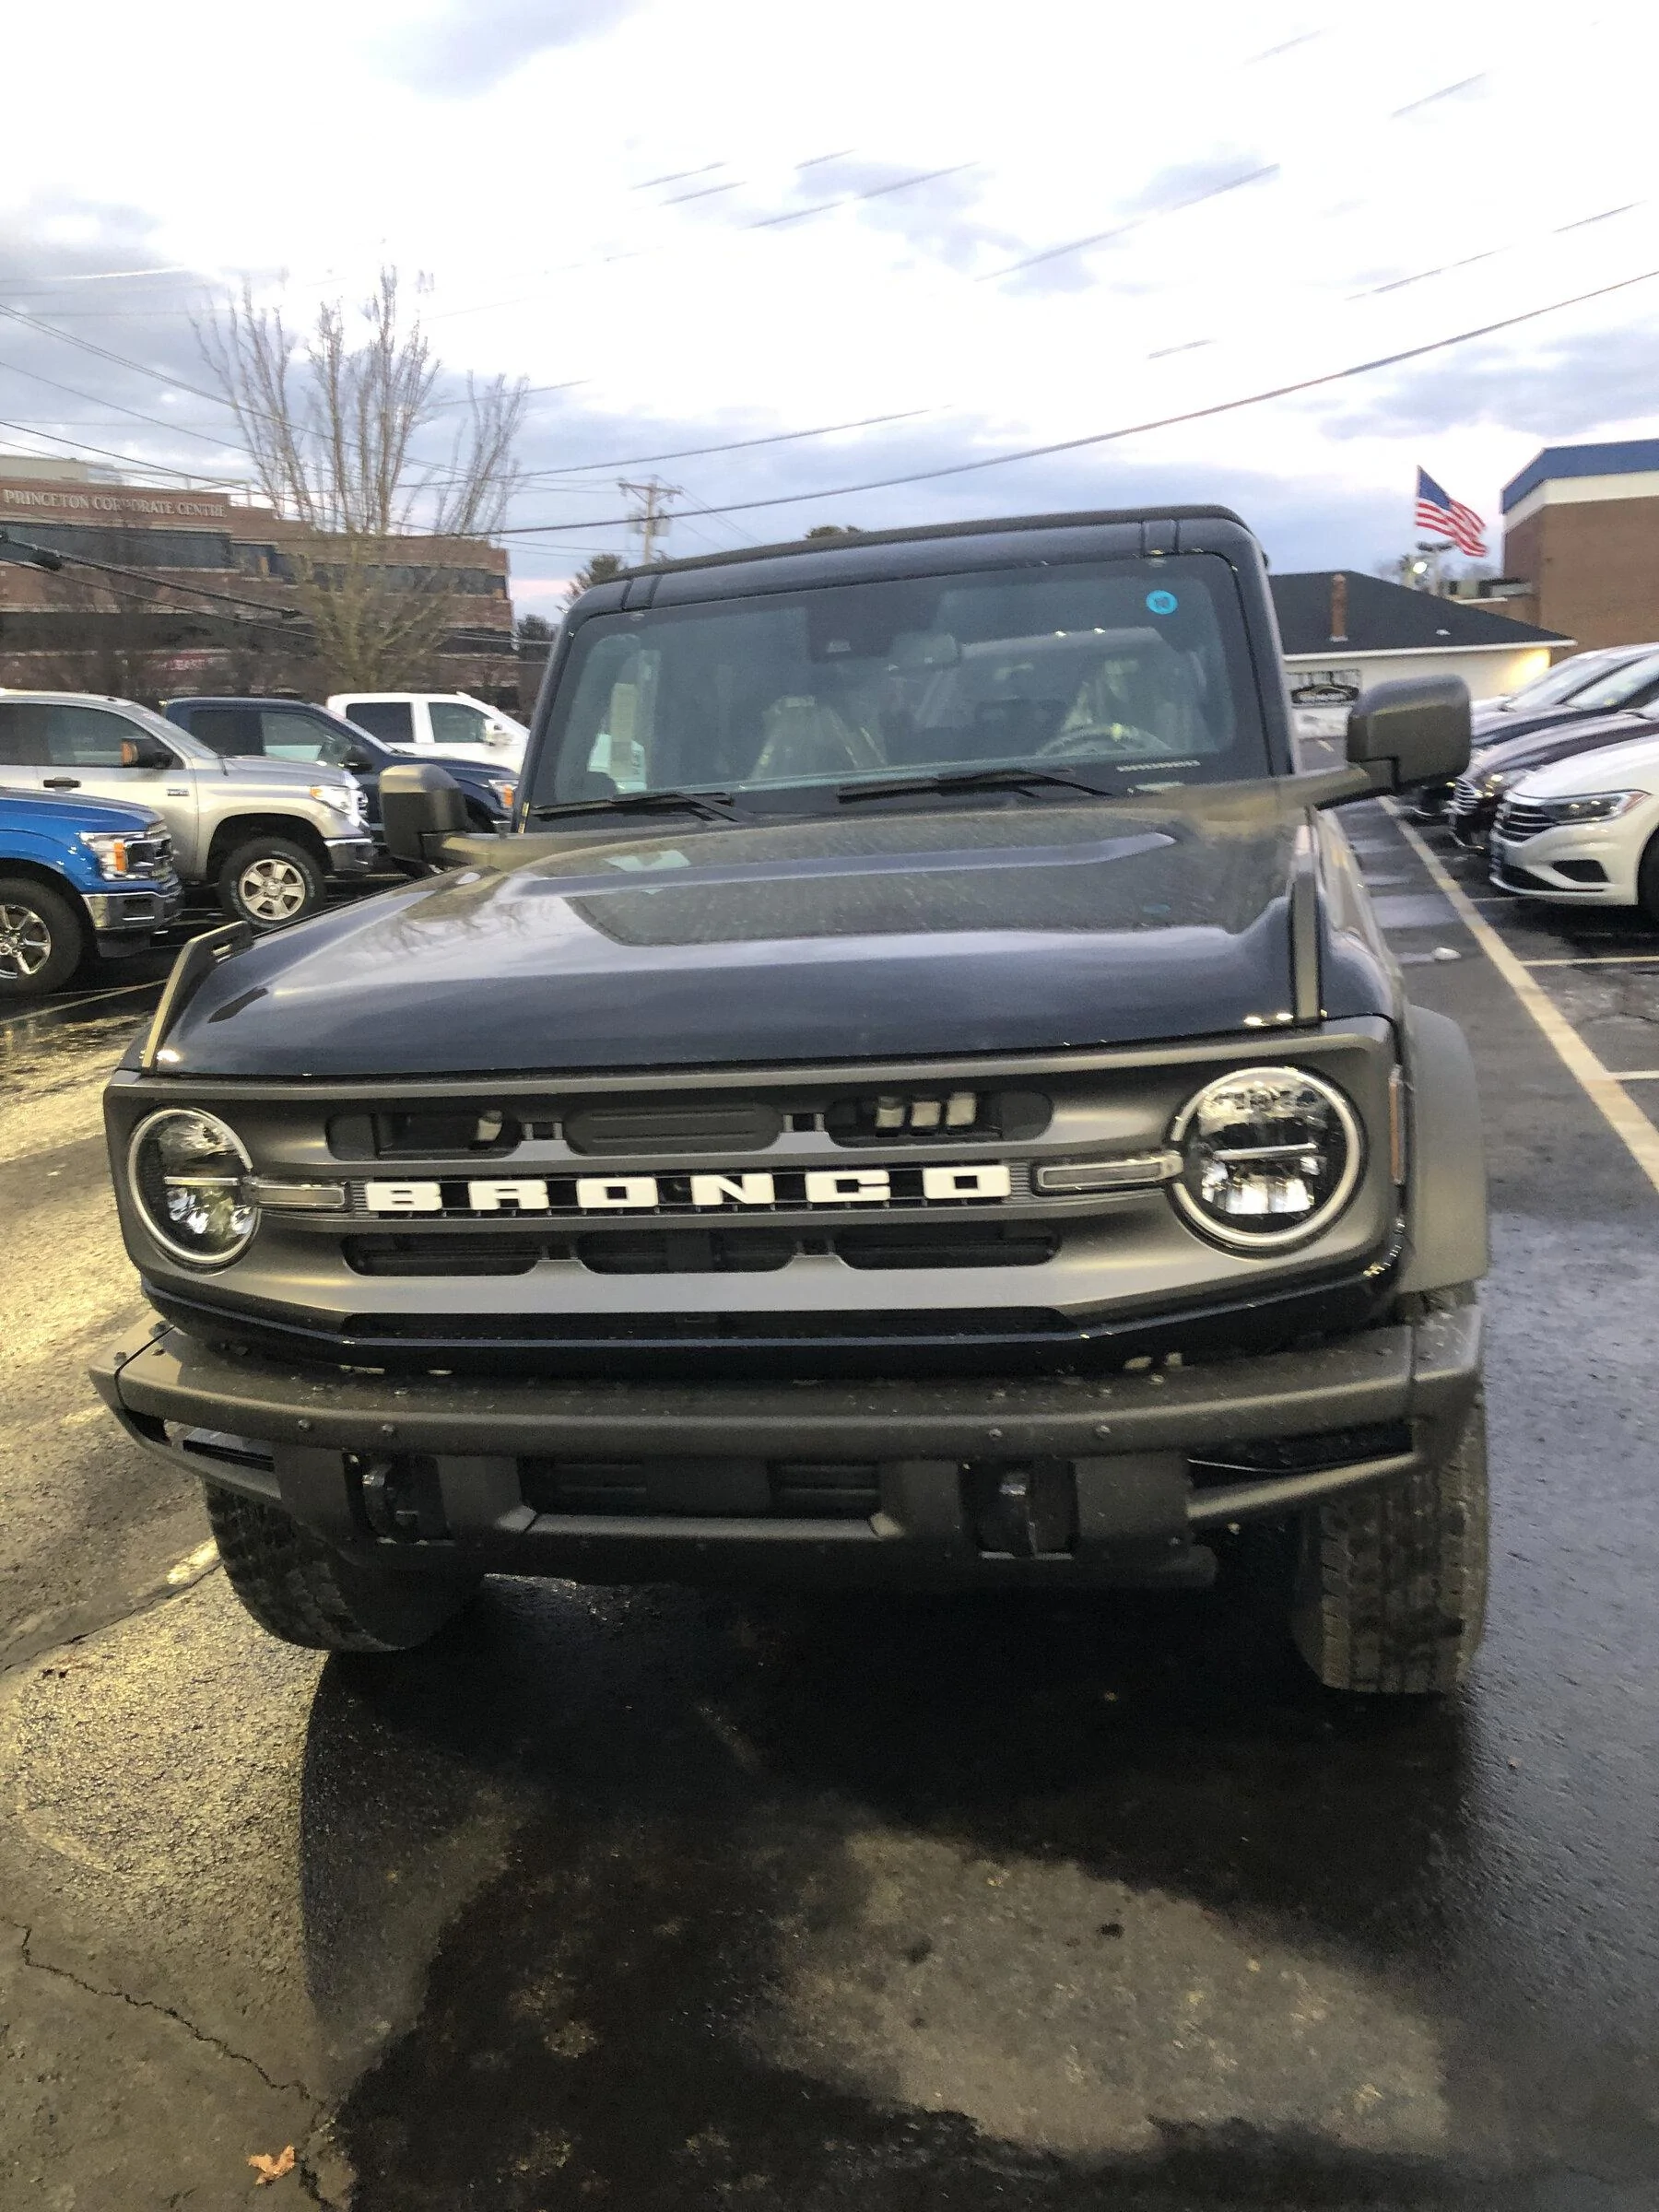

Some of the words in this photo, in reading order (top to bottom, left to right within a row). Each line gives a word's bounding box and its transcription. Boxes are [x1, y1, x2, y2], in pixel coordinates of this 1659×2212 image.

[3, 488, 89, 509] PRINCETON
[177, 501, 227, 518] CENTRE
[365, 1165, 1011, 1211] BRONCO
